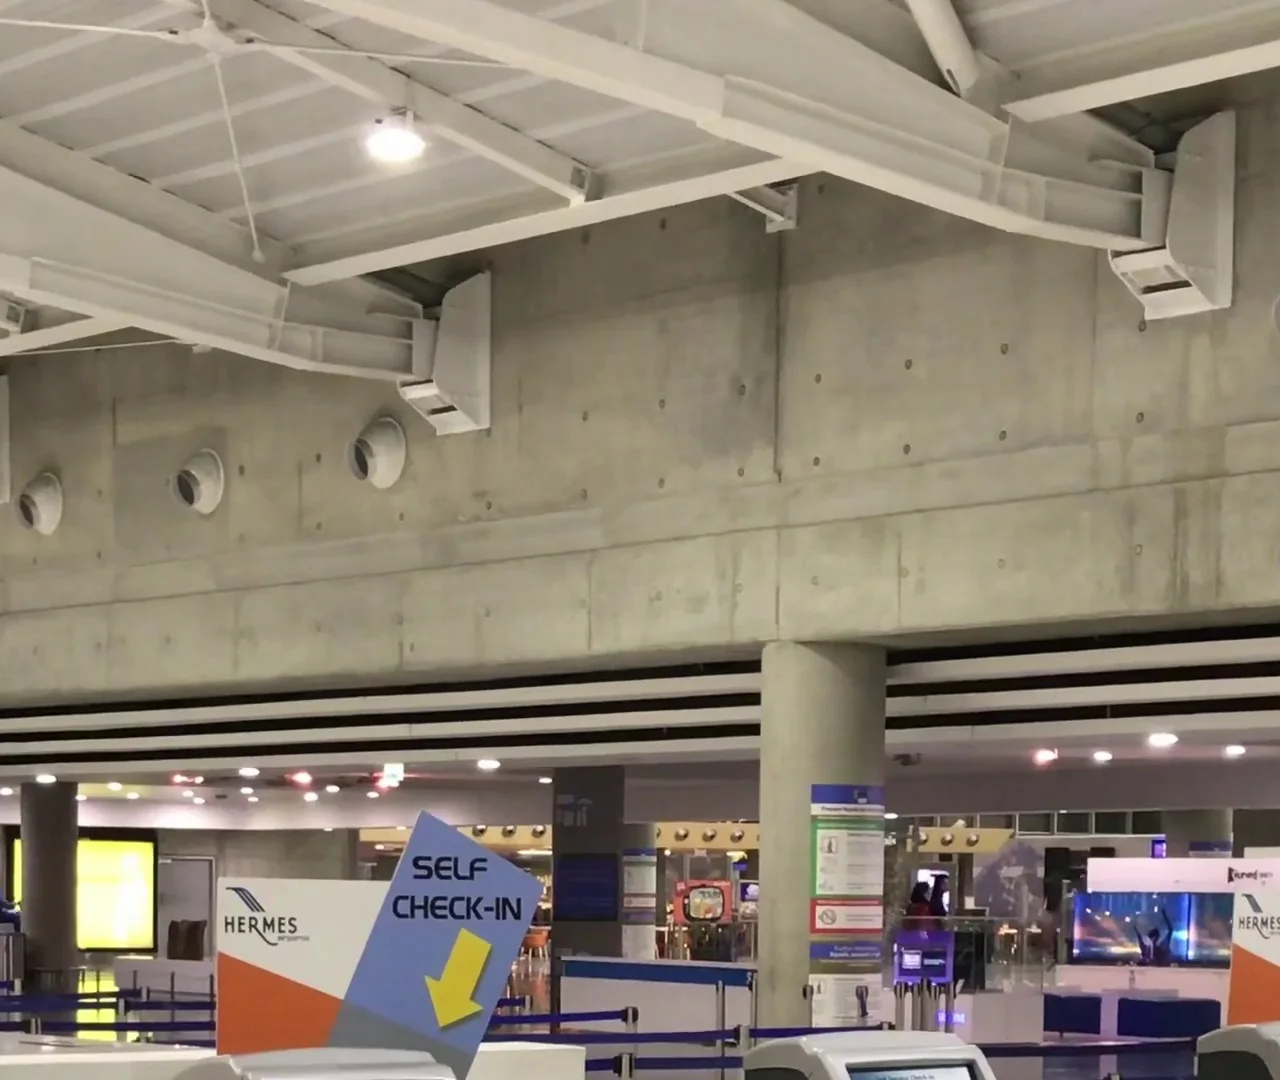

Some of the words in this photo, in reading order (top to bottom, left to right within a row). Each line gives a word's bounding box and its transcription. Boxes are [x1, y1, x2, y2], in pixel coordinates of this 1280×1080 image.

[412, 856, 488, 881] SELF
[392, 895, 521, 921] CHECK-IN
[224, 915, 297, 946] HERMES
